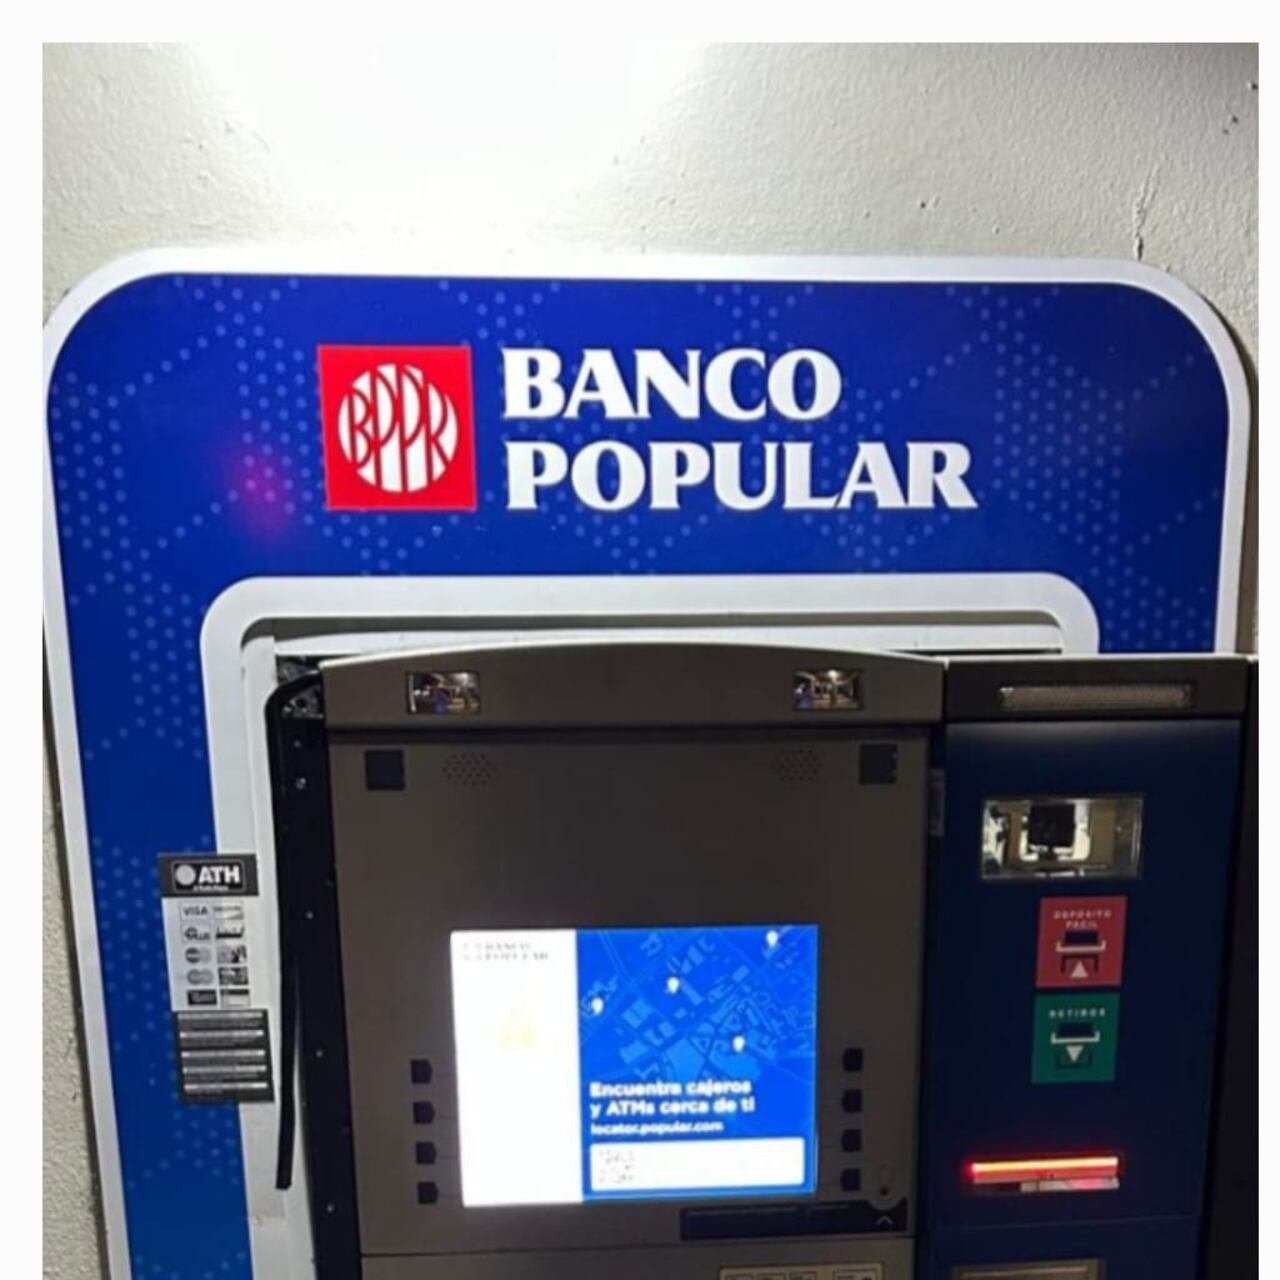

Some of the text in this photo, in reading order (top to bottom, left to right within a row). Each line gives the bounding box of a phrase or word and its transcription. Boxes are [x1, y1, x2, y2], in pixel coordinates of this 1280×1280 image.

[501, 347, 842, 421] BANCO
[338, 364, 458, 493] BPPR
[504, 440, 979, 512] POPULAR
[199, 865, 240, 884] ATH
[182, 906, 208, 916] VISA
[589, 1078, 752, 1097] Encuentra cajeros
[589, 1096, 756, 1118] y ATMs cerca de ti
[591, 1120, 724, 1135] locator.popular.com
